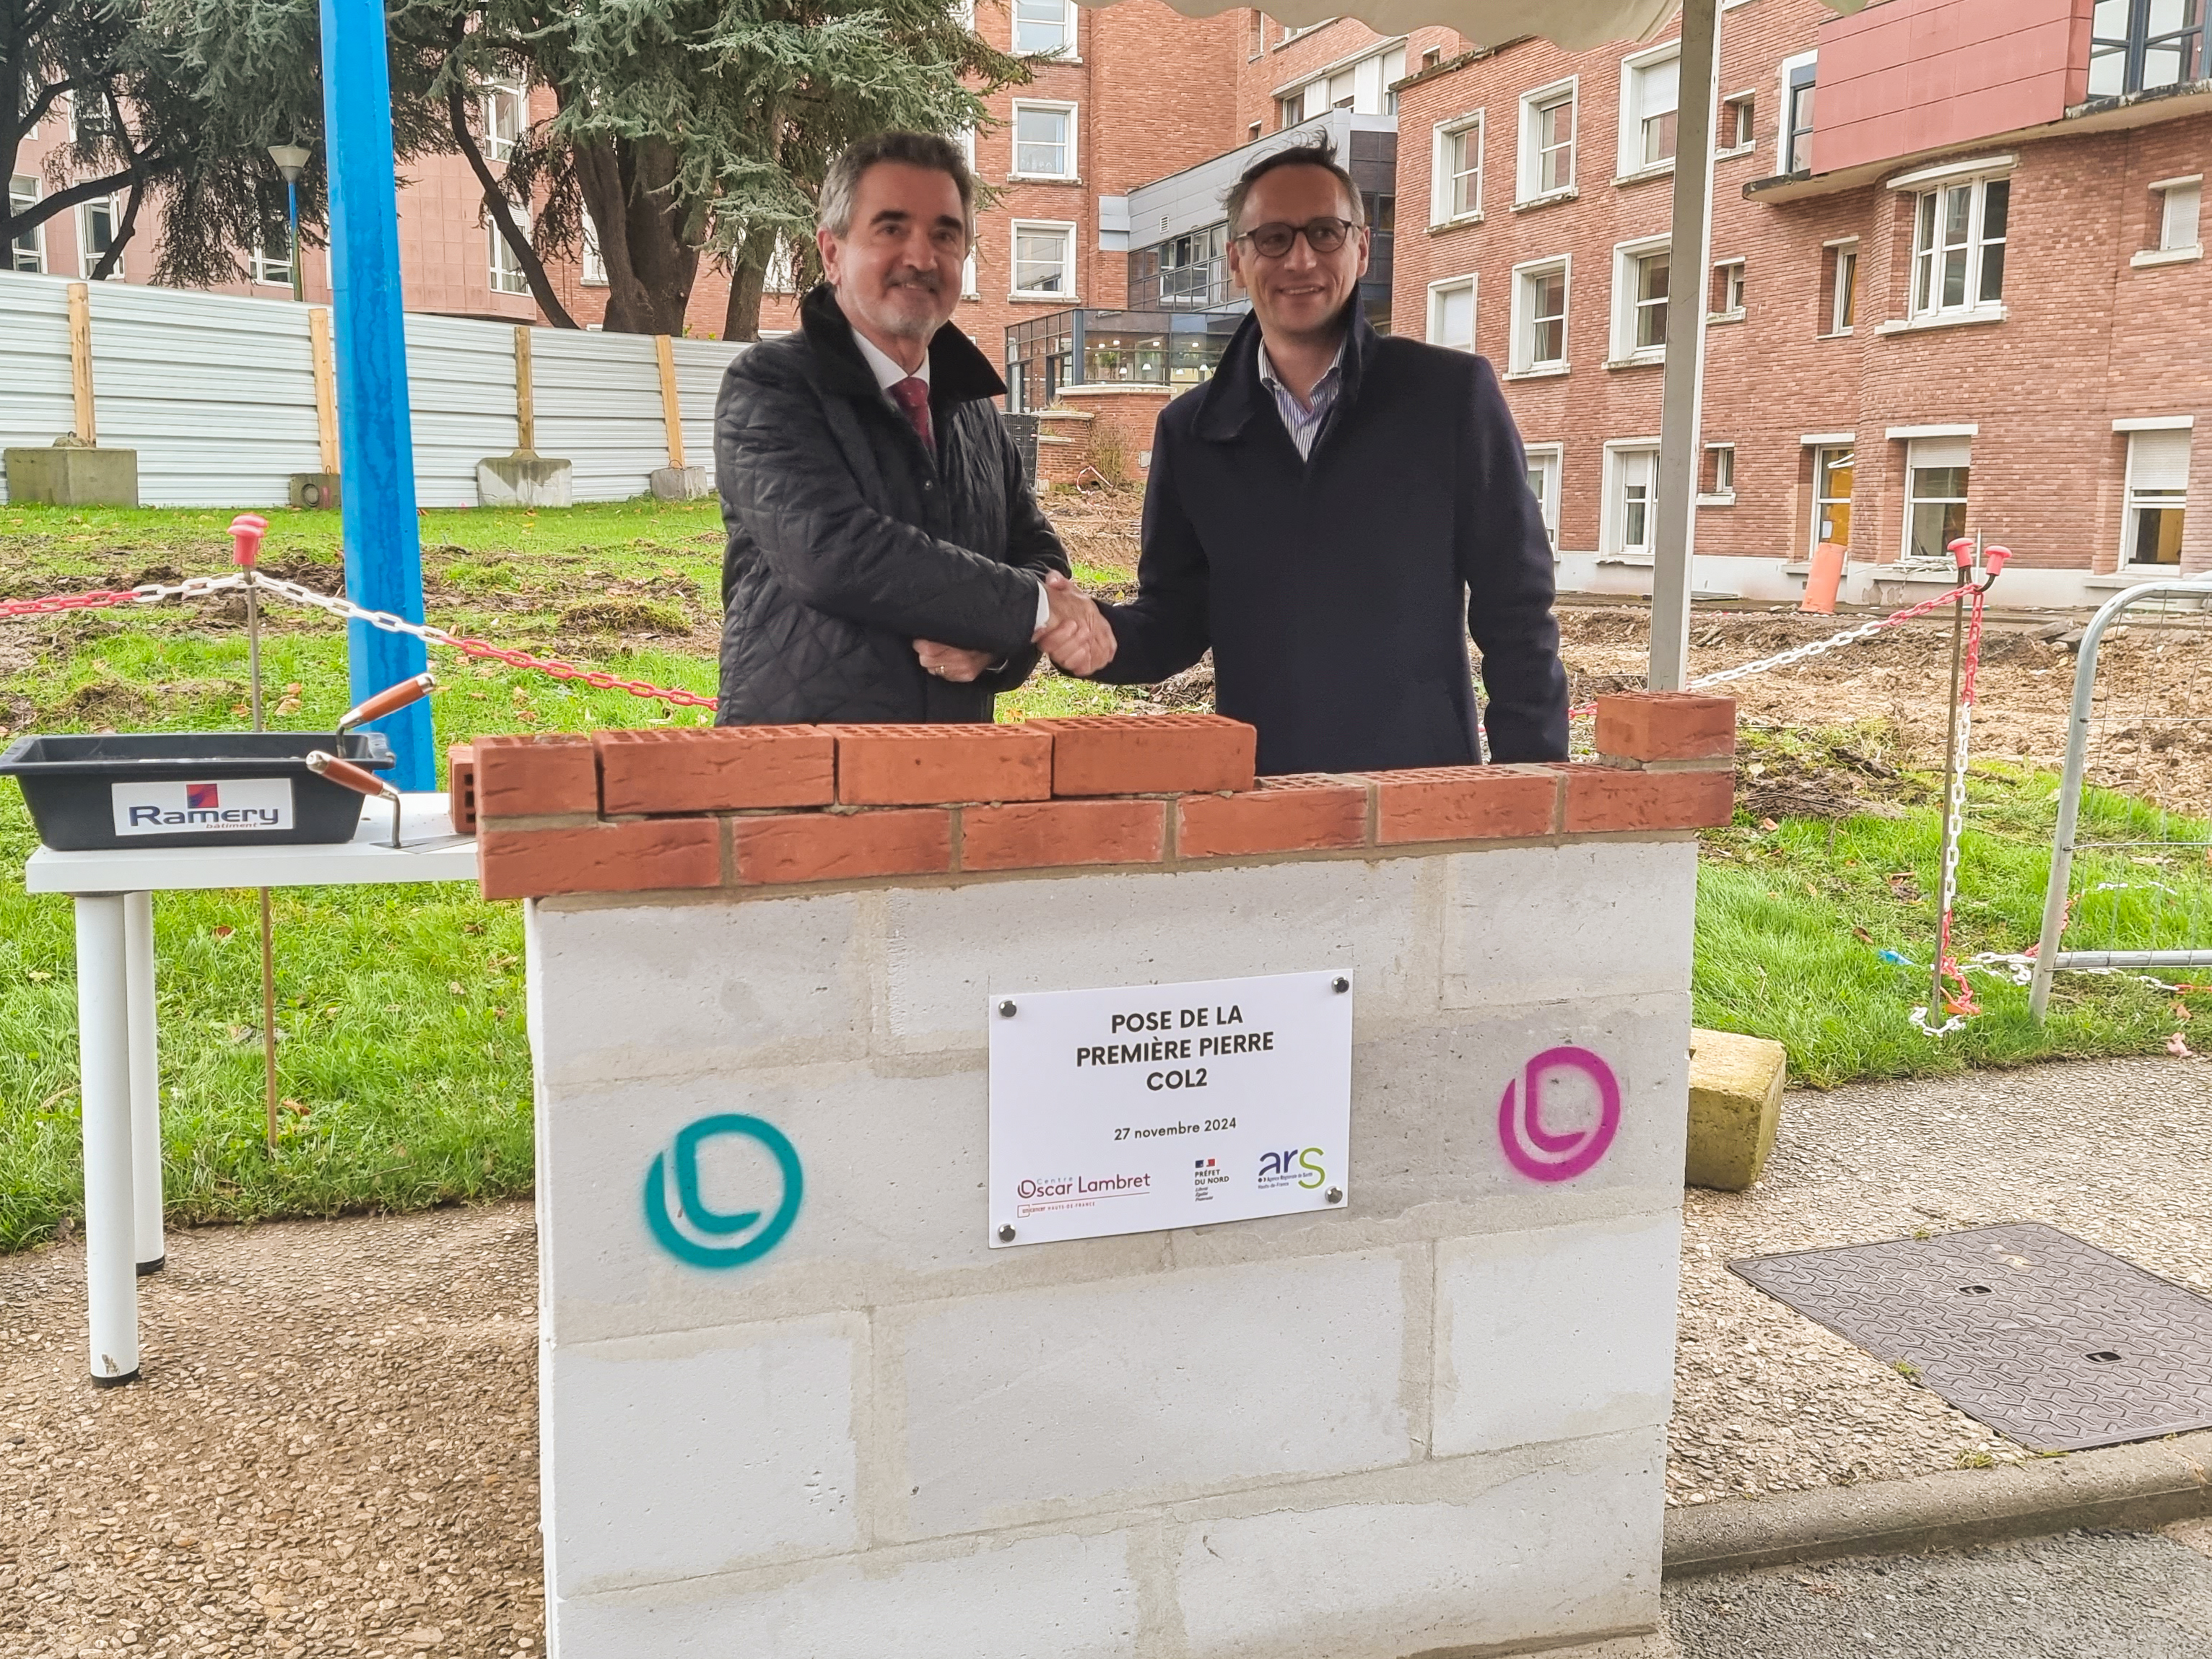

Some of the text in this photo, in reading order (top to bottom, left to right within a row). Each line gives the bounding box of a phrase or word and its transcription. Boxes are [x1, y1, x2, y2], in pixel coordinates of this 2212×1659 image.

[129, 806, 279, 827] Ramery
[1111, 1005, 1243, 1034] POSE DE LA
[1076, 1031, 1273, 1067] PREMIÈRE PIERRE
[1146, 1068, 1208, 1092] COL2
[1114, 1117, 1237, 1141] 27 novembre 2024
[1037, 1176, 1074, 1185] Centre
[1195, 1169, 1220, 1177] PRÉFET
[1207, 1175, 1229, 1184] NORD
[1017, 1173, 1151, 1199] Oscar Lambret
